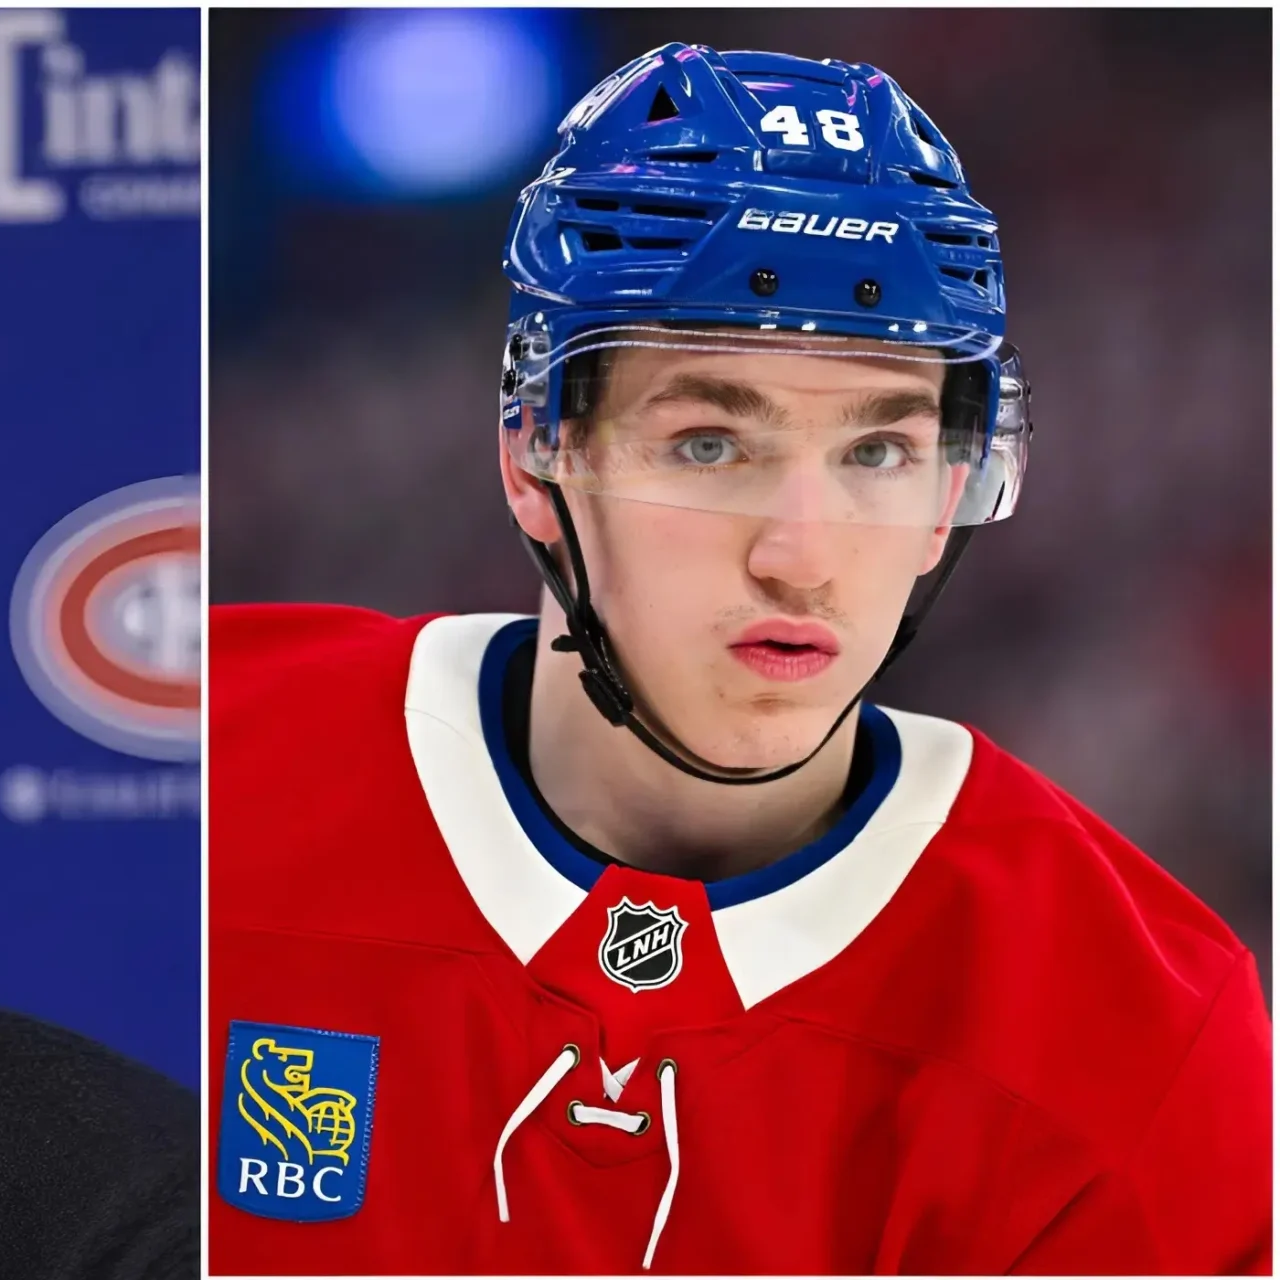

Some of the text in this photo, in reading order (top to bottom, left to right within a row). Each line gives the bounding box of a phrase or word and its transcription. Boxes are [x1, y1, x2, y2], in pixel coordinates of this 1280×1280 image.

[760, 105, 865, 152] 48
[615, 923, 671, 969] LNH
[238, 1157, 344, 1202] RBC
